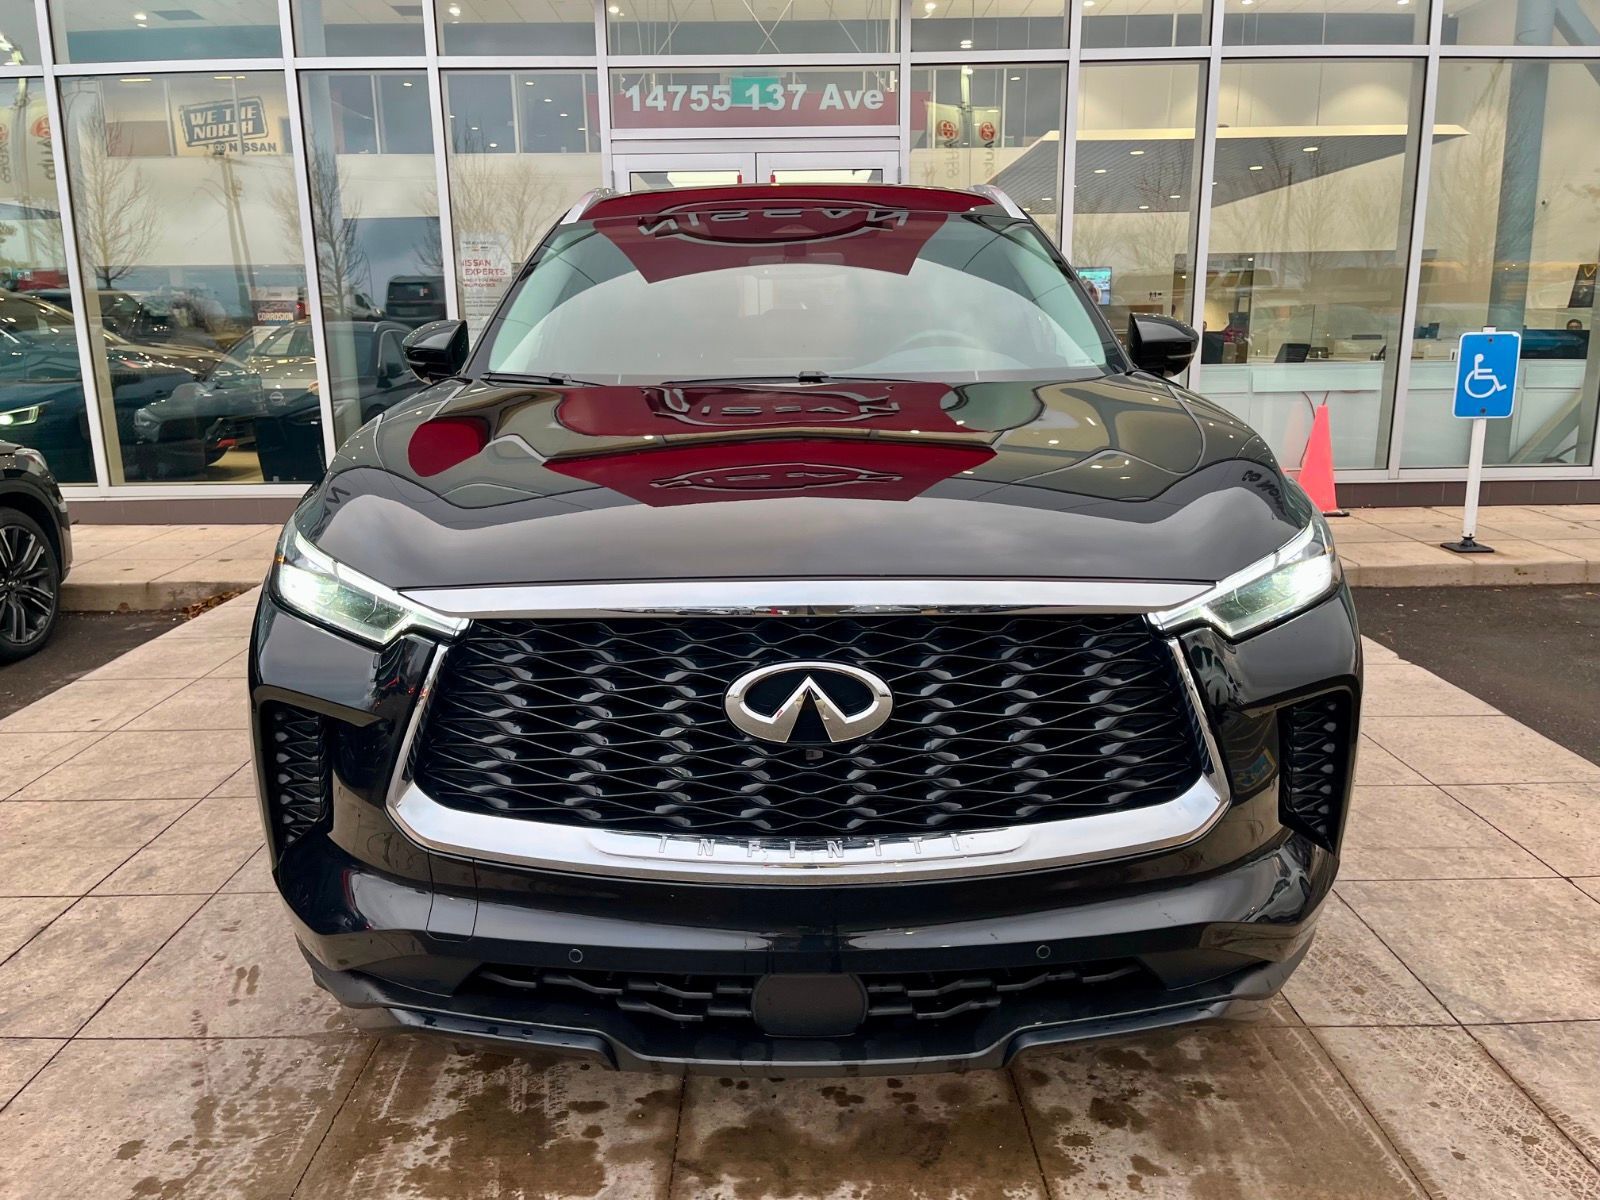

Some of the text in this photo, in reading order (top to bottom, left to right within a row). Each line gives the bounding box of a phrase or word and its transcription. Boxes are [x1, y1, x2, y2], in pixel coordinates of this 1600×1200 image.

[625, 83, 884, 112] 14755 137 Ave
[190, 110, 217, 126] WE
[193, 121, 254, 139] NORTH
[229, 142, 276, 152] NSSAN
[257, 312, 294, 321] CORROSION
[657, 833, 961, 859] INFINITI
